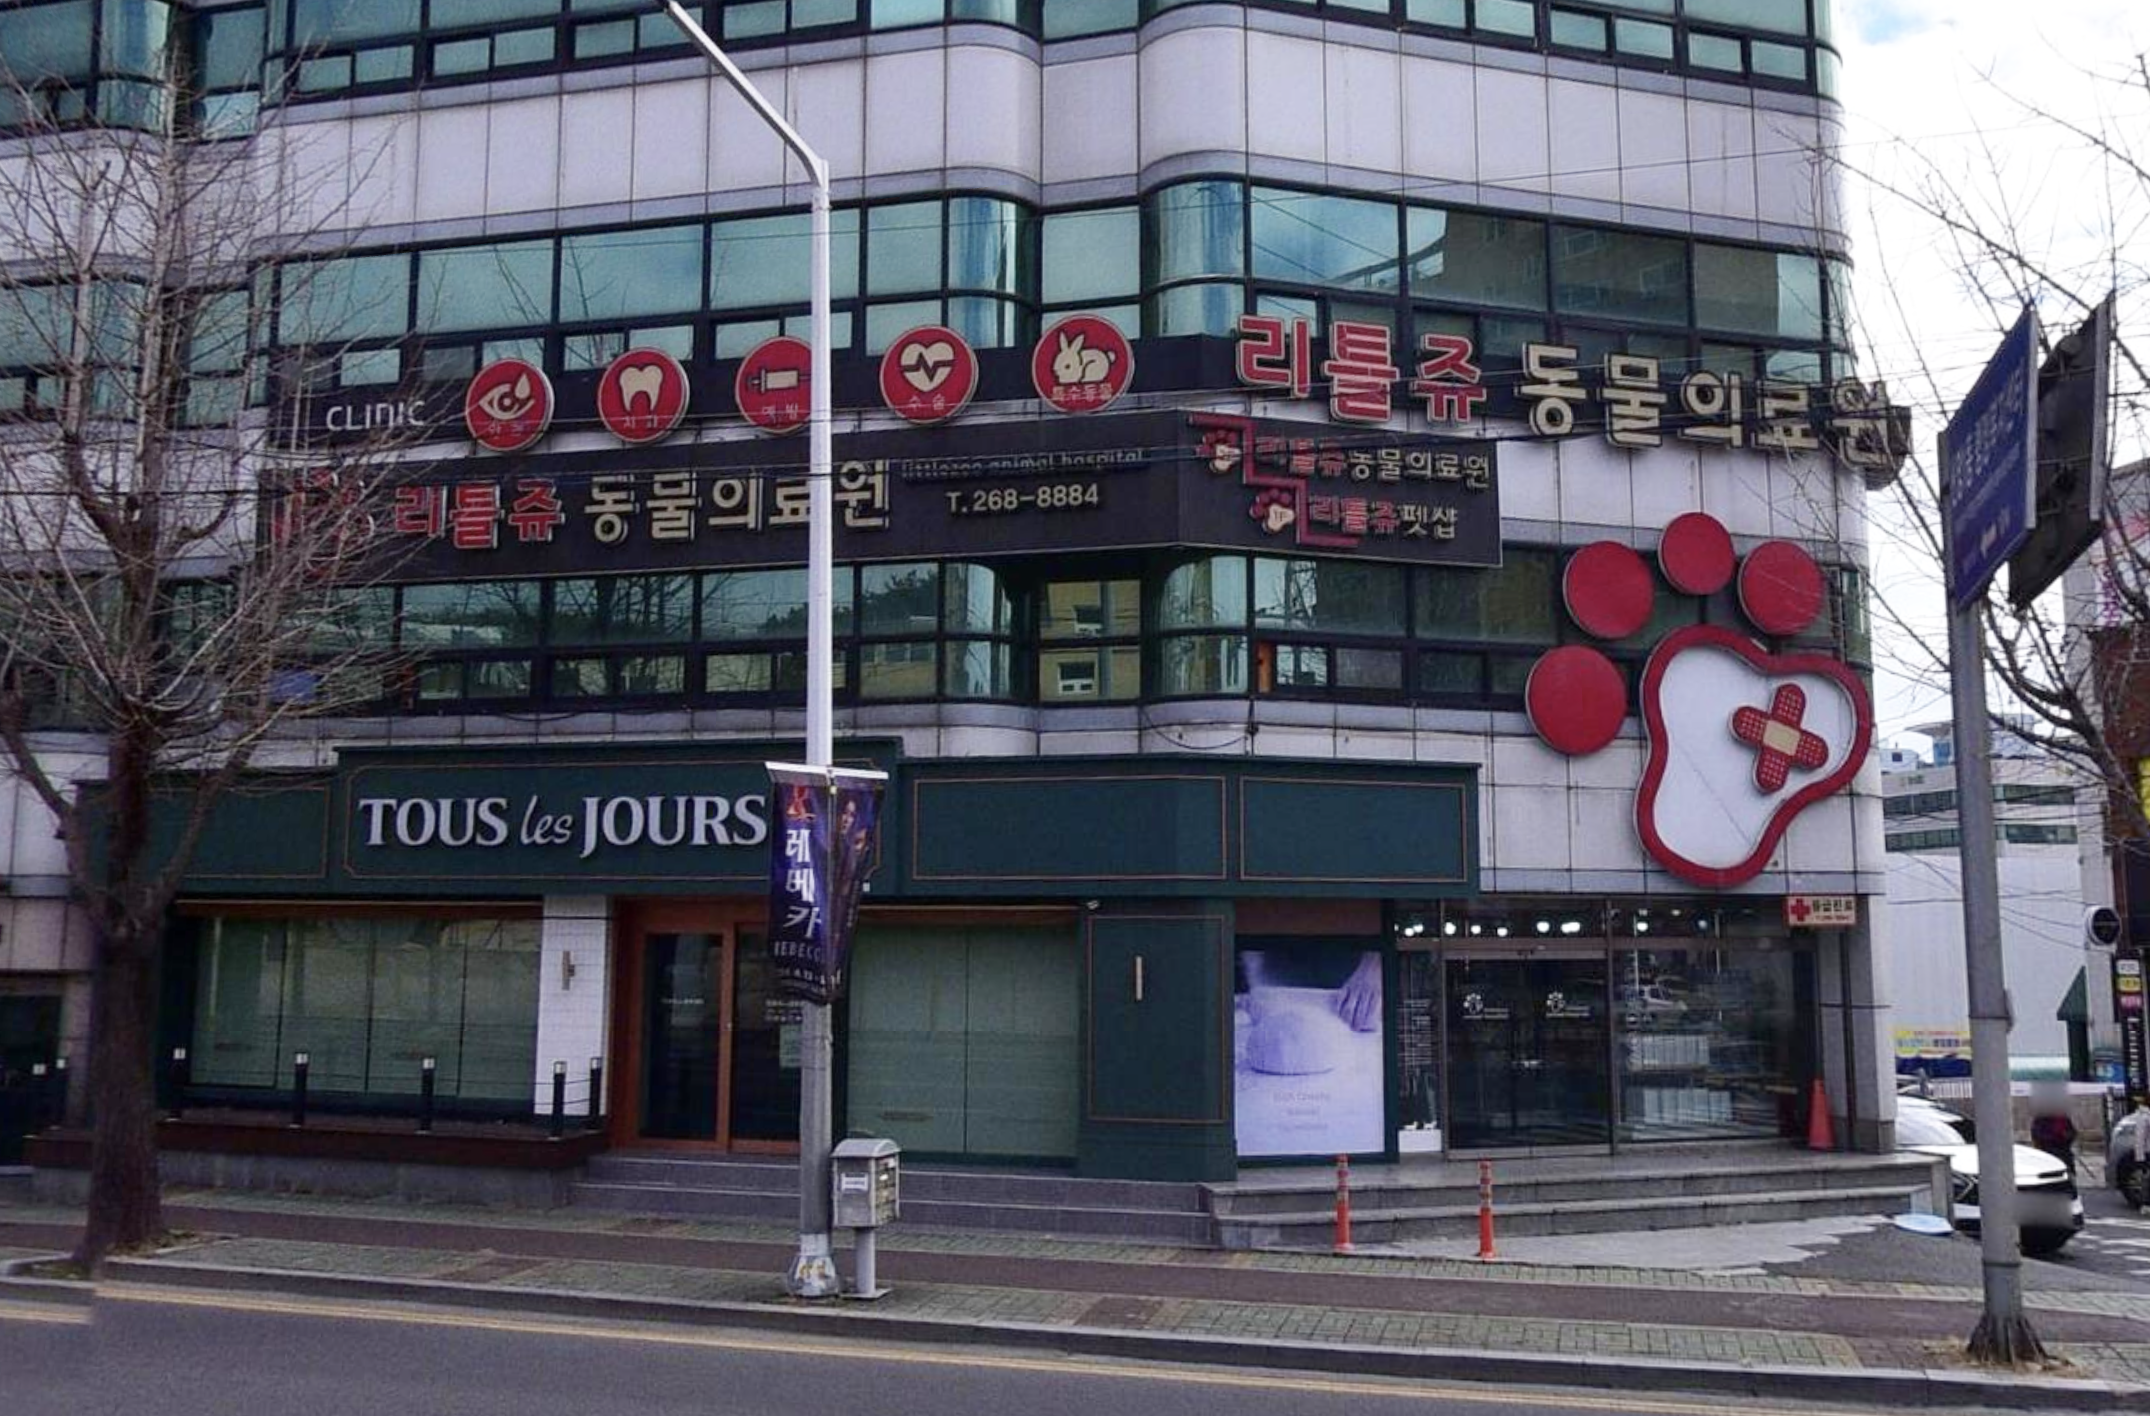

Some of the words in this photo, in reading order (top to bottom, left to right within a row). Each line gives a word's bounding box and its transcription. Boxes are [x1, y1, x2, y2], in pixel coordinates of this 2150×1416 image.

[1236, 314, 1488, 423] 리틀쥬
[394, 478, 566, 549] 리틀쥬
[583, 458, 890, 543] 동물의료원
[946, 482, 1100, 514] T.268-8884
[358, 797, 508, 848] TOUS
[519, 795, 573, 846] les
[579, 794, 768, 859] JOURS
[782, 828, 823, 940] 레베카
